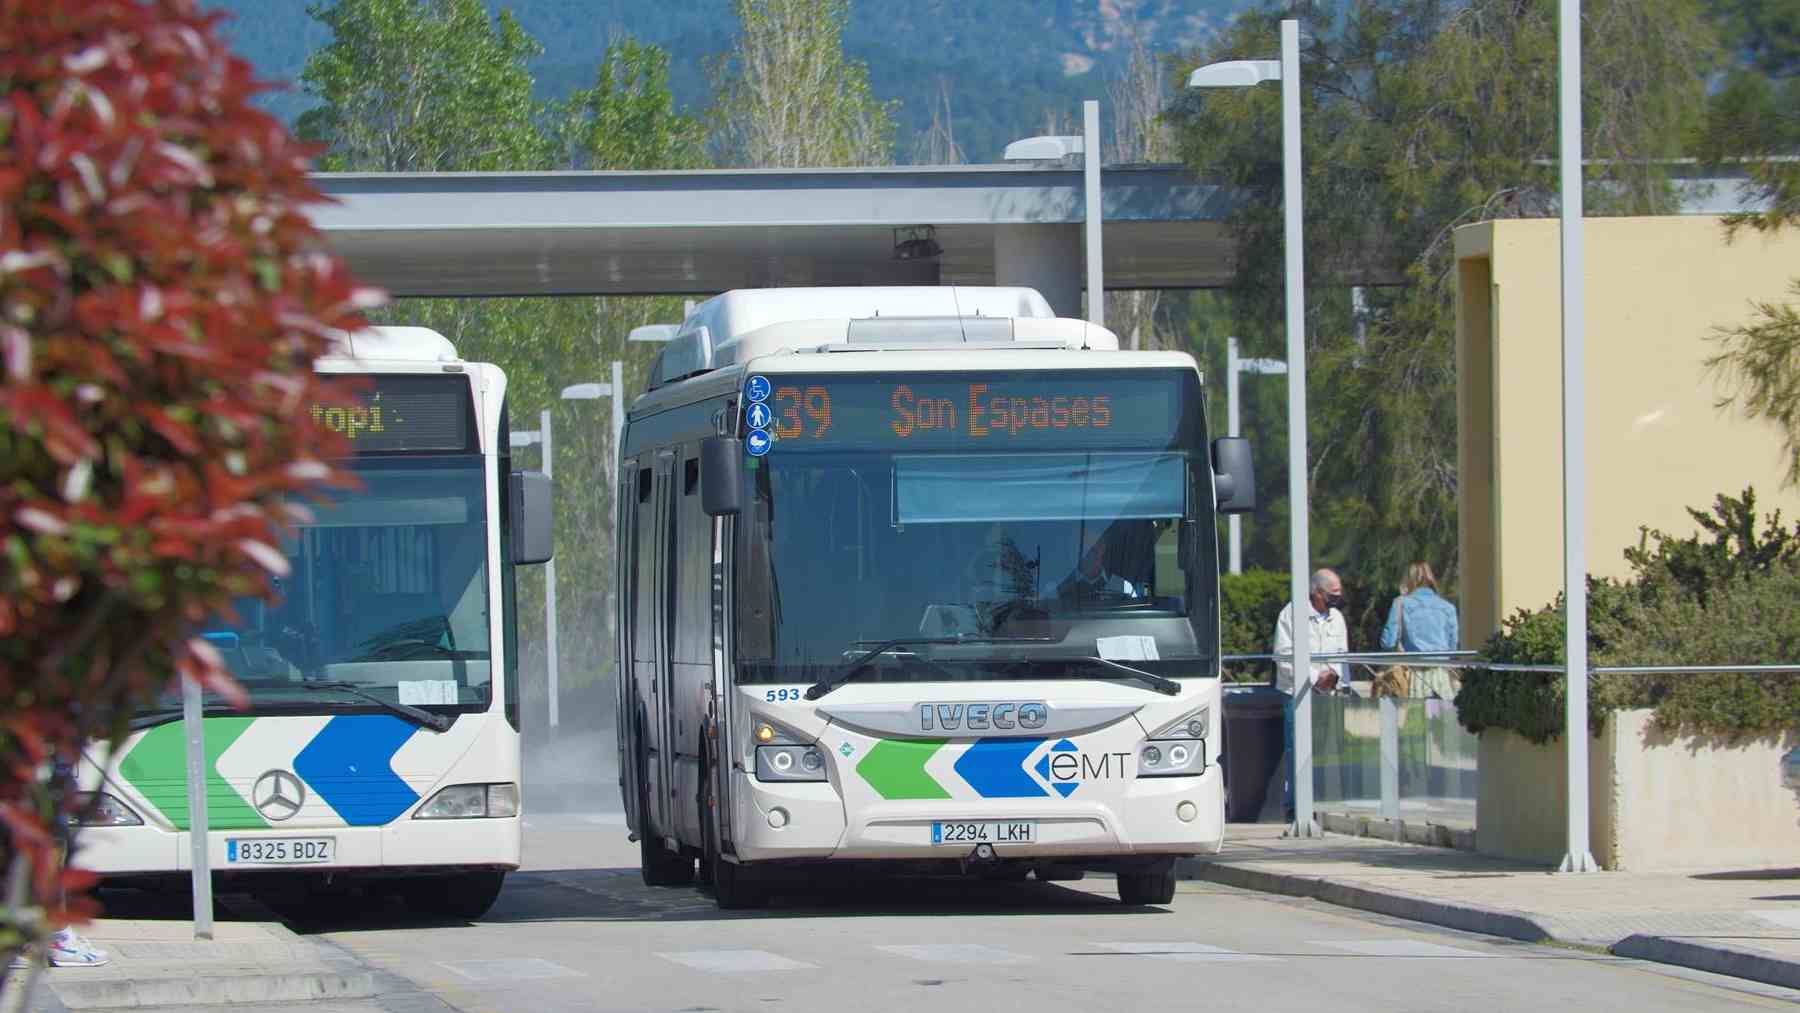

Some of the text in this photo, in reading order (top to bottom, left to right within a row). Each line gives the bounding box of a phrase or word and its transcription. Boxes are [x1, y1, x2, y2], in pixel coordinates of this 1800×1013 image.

[776, 384, 1112, 438] 39 Son Espases
[766, 688, 800, 702] 593
[920, 703, 1048, 730] IVECO
[944, 823, 1030, 841] 2294 LKH
[240, 842, 328, 859] 8325 BDZ
